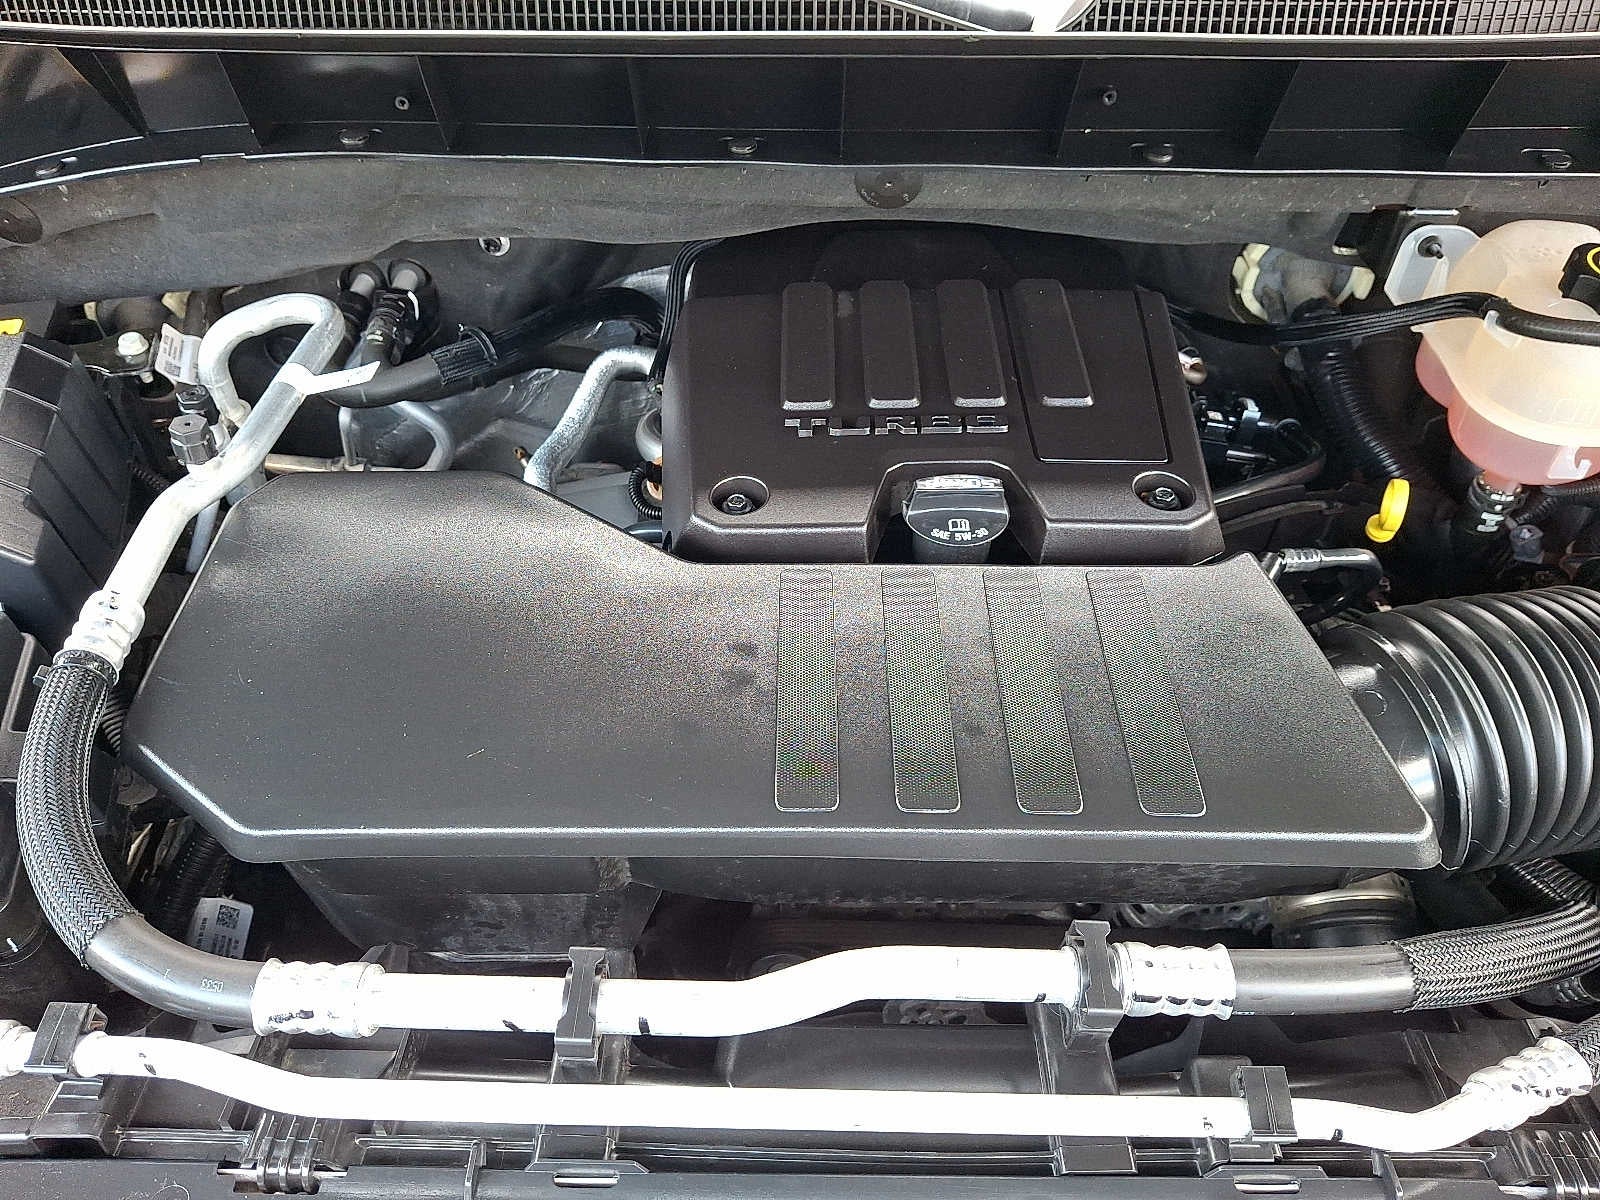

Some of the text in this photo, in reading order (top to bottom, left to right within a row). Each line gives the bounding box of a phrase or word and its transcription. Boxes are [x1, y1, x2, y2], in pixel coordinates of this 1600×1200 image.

[784, 415, 1009, 437] TURBO
[930, 527, 989, 541] SAE 5W-30
